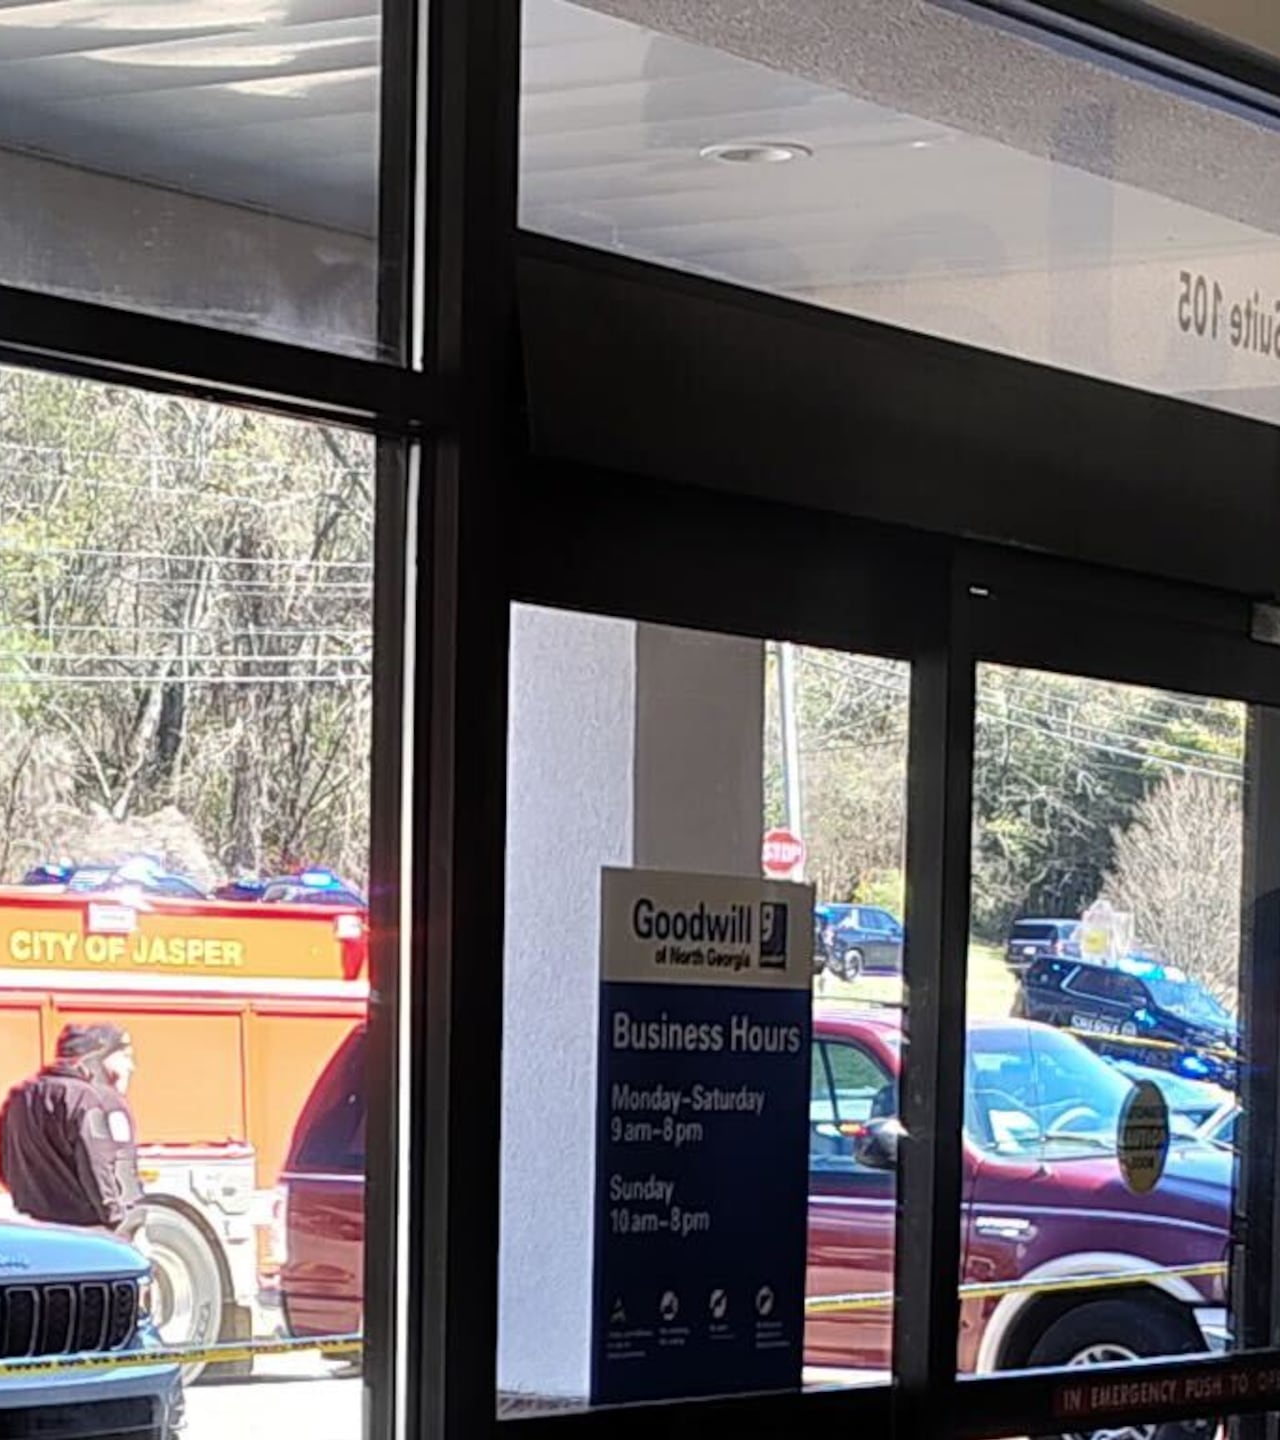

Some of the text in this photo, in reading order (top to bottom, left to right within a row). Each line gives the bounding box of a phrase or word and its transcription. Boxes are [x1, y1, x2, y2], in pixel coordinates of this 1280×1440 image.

[761, 841, 801, 863] STOP
[633, 898, 752, 944] Goodwill
[9, 929, 244, 966] CITY OF JASPER
[655, 945, 667, 964] of
[669, 946, 705, 966] North
[707, 947, 752, 971] Georgia
[612, 1011, 801, 1053] Business Hours
[610, 1173, 675, 1206] Sunday
[1063, 1388, 1083, 1411] IN
[1090, 1378, 1178, 1409] EMERGENCY
[1184, 1375, 1223, 1400] PUSH
[1229, 1371, 1250, 1395] TO
